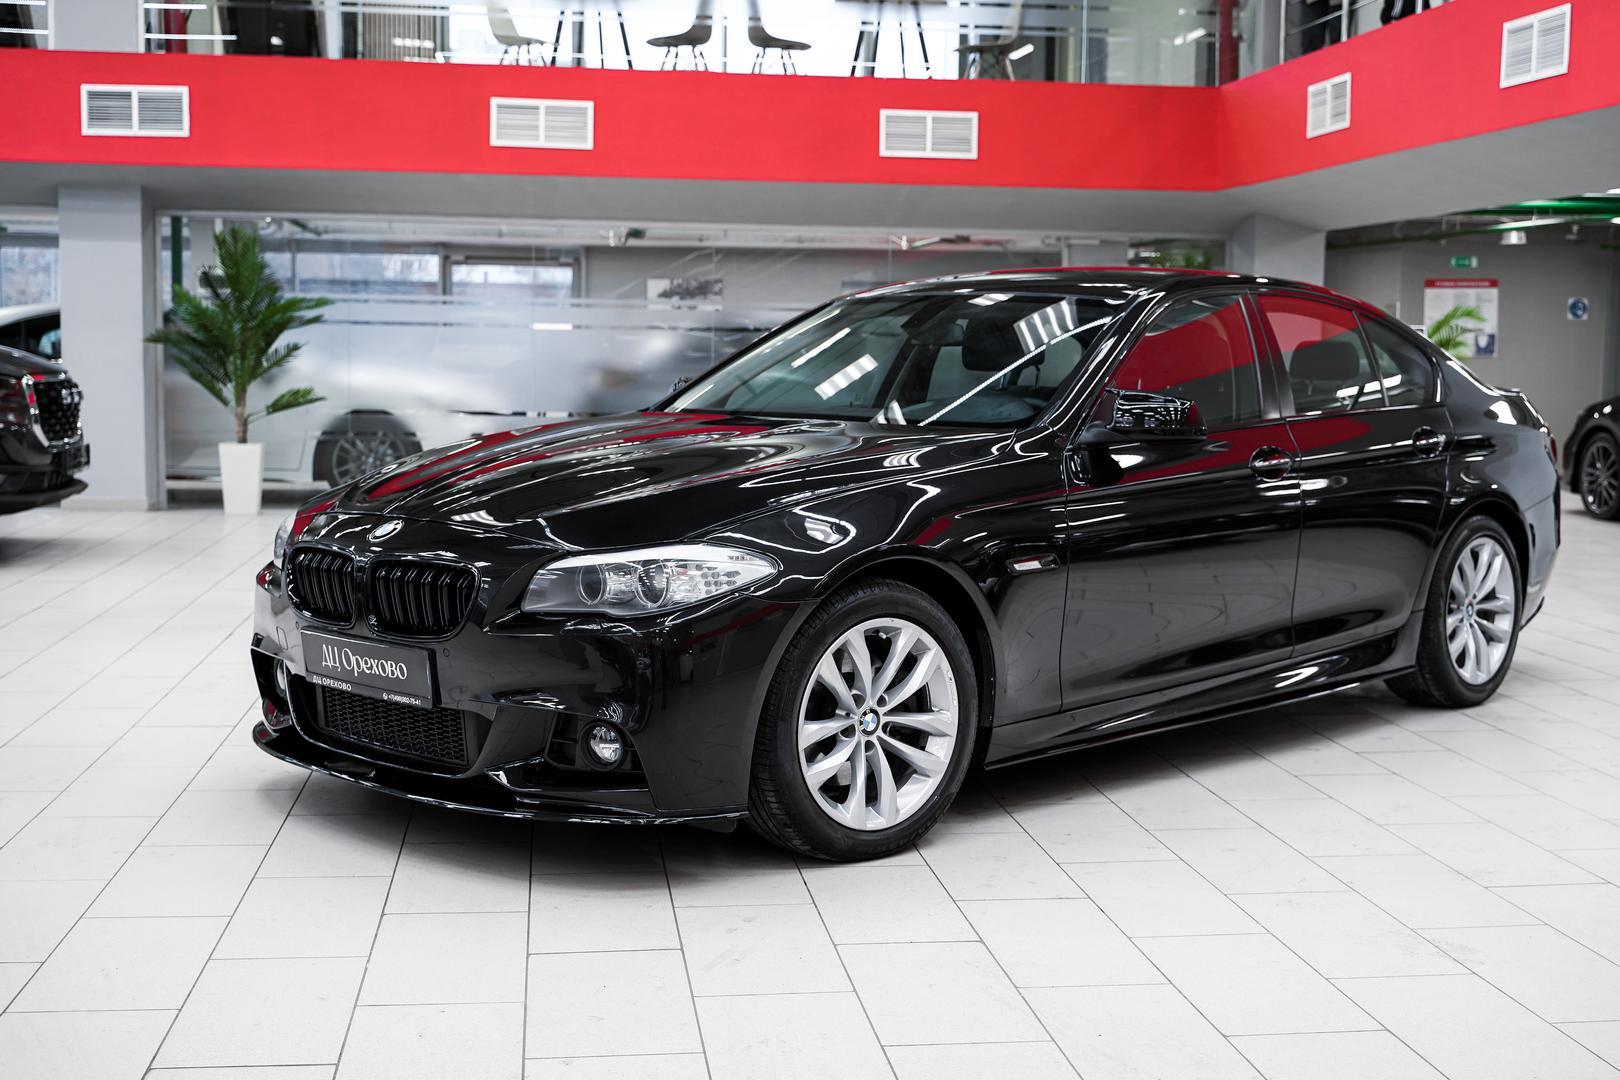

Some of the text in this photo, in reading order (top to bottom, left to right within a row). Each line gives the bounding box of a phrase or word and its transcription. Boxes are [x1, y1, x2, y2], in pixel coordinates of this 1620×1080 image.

[322, 644, 408, 680] ДЦ Орехово
[322, 677, 352, 691] ОРЕХОВО
